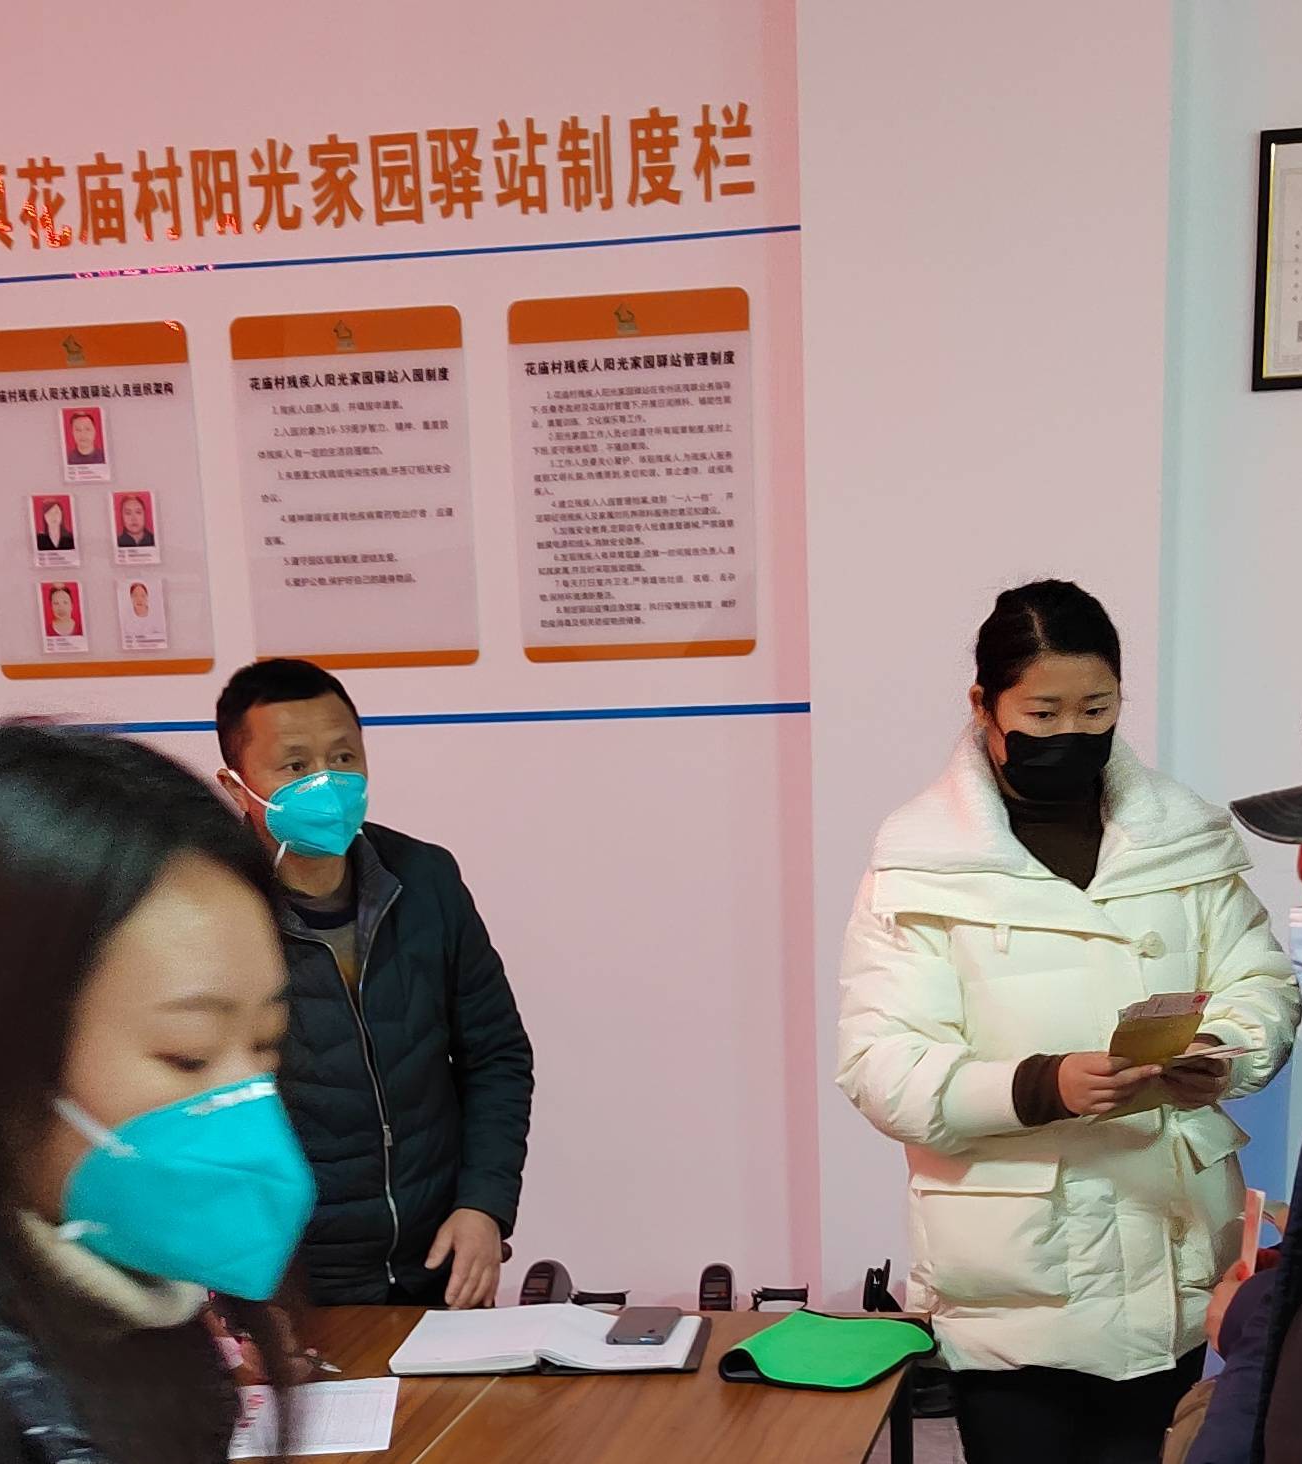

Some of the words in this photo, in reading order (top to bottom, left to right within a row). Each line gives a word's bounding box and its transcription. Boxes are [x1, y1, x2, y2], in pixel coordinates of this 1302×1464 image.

[524, 350, 735, 376] 花庙村残疾人阳光家园驿站管理制度
[249, 366, 450, 391] 花庙村残疾人阳光家园驿站入园制度
